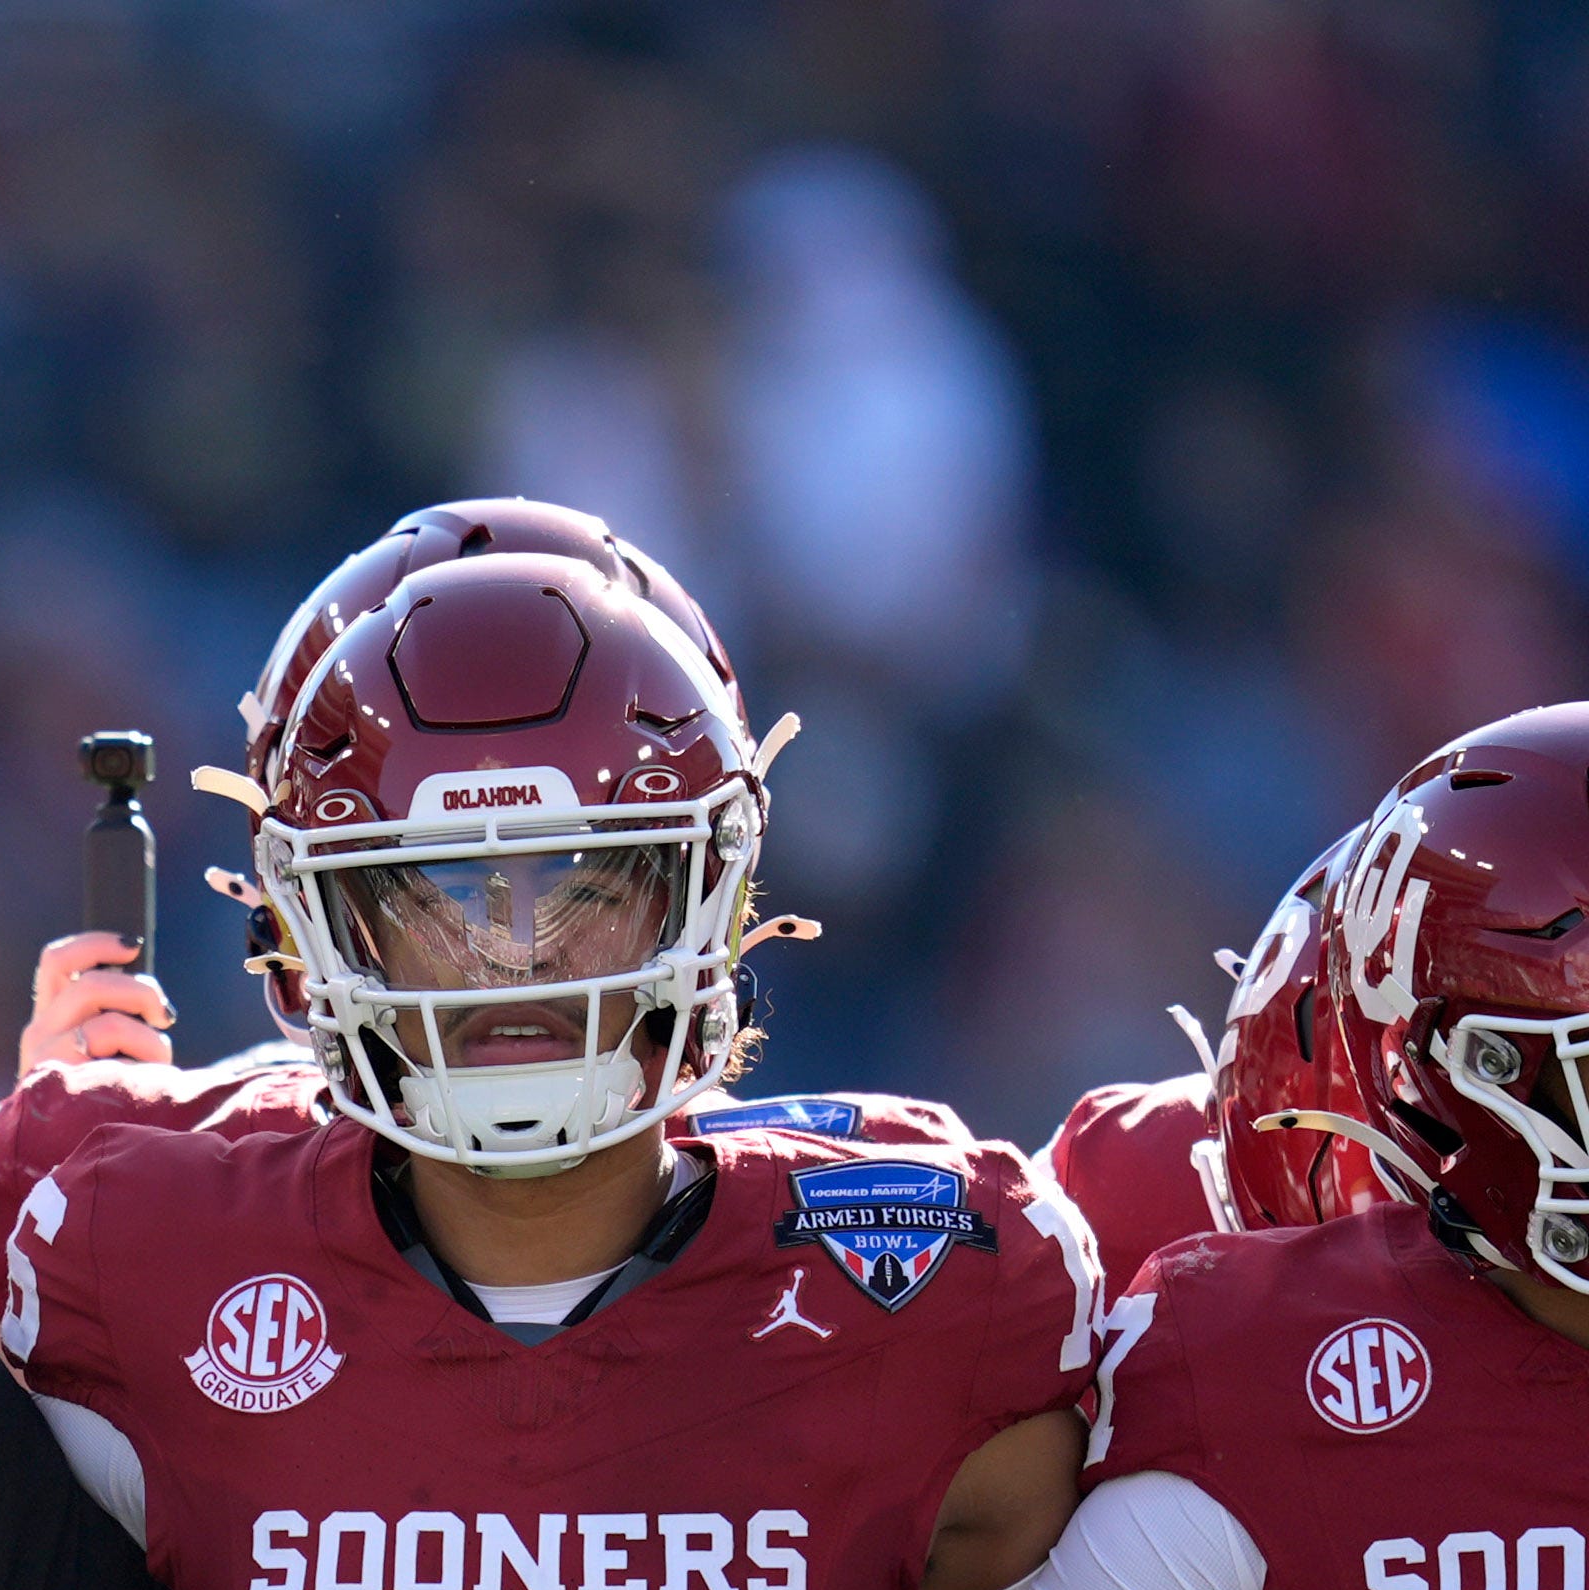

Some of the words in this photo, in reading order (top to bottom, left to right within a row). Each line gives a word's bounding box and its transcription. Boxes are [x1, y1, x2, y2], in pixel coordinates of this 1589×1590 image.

[442, 784, 543, 811] OKLAHOMA
[809, 1188, 869, 1198] LOCKHEED
[871, 1187, 917, 1196] MARTIN
[795, 1207, 875, 1232] ARMED
[881, 1206, 974, 1232] FORCES
[854, 1235, 919, 1249] BOWL
[219, 1282, 316, 1376] SEC
[1317, 1326, 1421, 1425] SEC
[200, 1371, 322, 1410] GRADUATE
